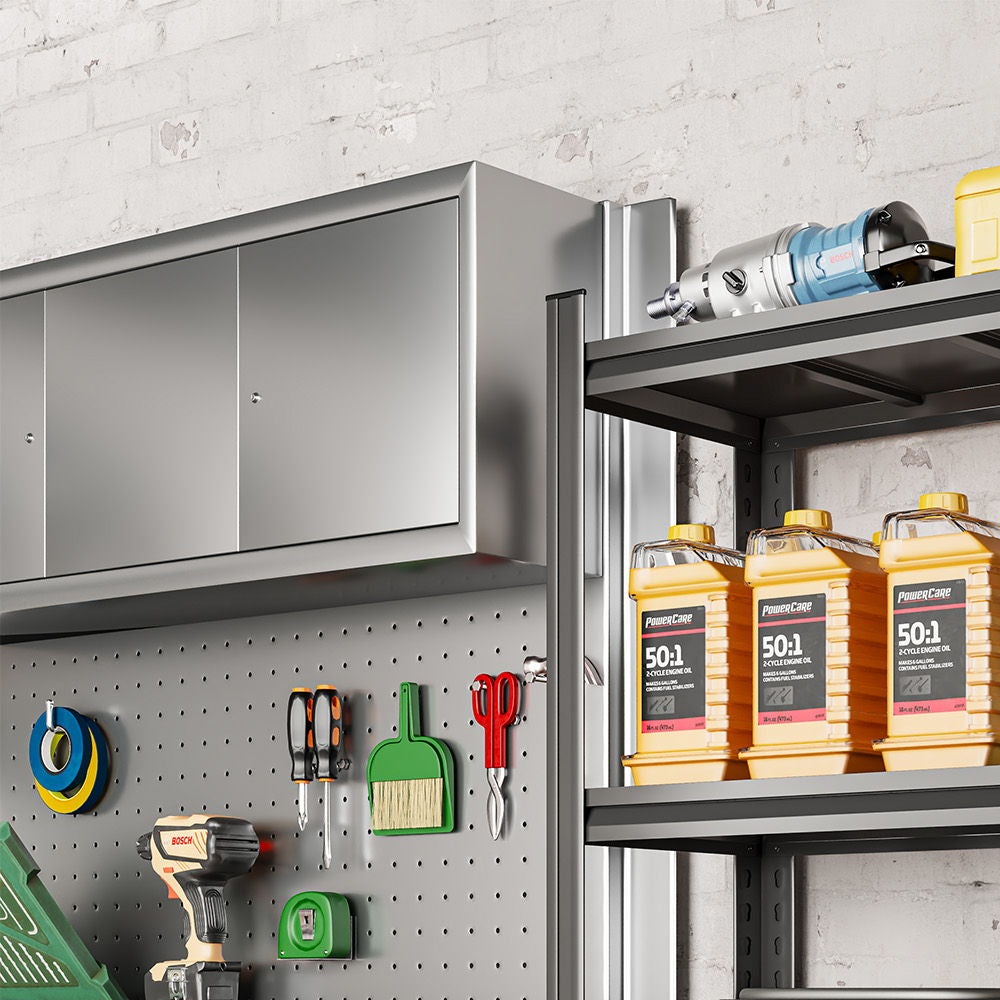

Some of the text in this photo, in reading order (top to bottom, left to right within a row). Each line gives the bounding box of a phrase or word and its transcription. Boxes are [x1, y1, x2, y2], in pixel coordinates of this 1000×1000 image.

[898, 620, 942, 647] 50:1
[762, 633, 803, 659] 50:1
[898, 647, 920, 655] 2-CYCLE
[921, 646, 941, 654] ENGINE
[645, 644, 684, 669] 50:1
[784, 658, 803, 666] ENGINE
[666, 668, 684, 676] ENGINE
[171, 836, 193, 845] BOSCH
